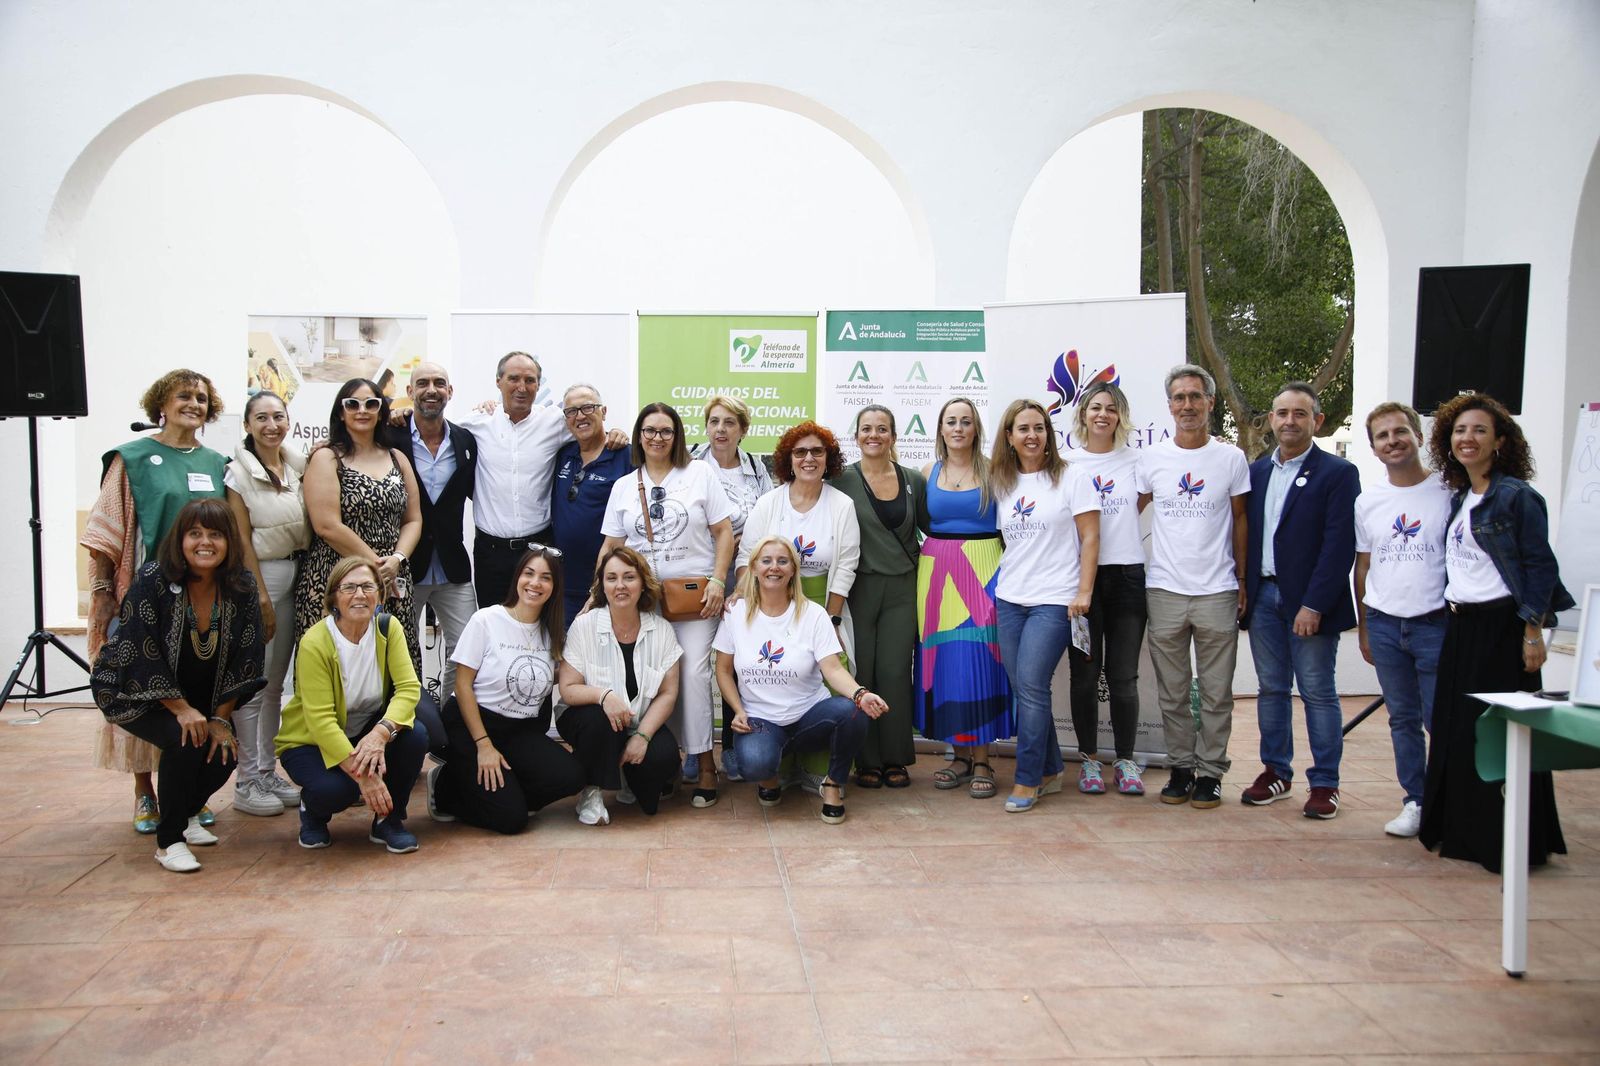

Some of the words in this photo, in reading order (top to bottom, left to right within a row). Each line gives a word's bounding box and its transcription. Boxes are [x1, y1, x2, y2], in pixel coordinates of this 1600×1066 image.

[859, 323, 881, 331] Junta
[869, 330, 906, 338] Andalucía
[763, 343, 791, 351] Teléfono
[770, 353, 804, 361] esperanza
[760, 361, 795, 369] Almería
[671, 386, 750, 399] CUIDAMOS
[752, 387, 780, 400] DEL
[843, 397, 874, 406] FAISEM
[901, 398, 932, 407] FAISEM
[748, 406, 809, 419] OCIONAL
[292, 422, 329, 447] Aspe
[900, 451, 930, 460] FAISEM
[741, 668, 799, 679] PSICOLOGÍA
[751, 676, 788, 685] ACCIÓN
